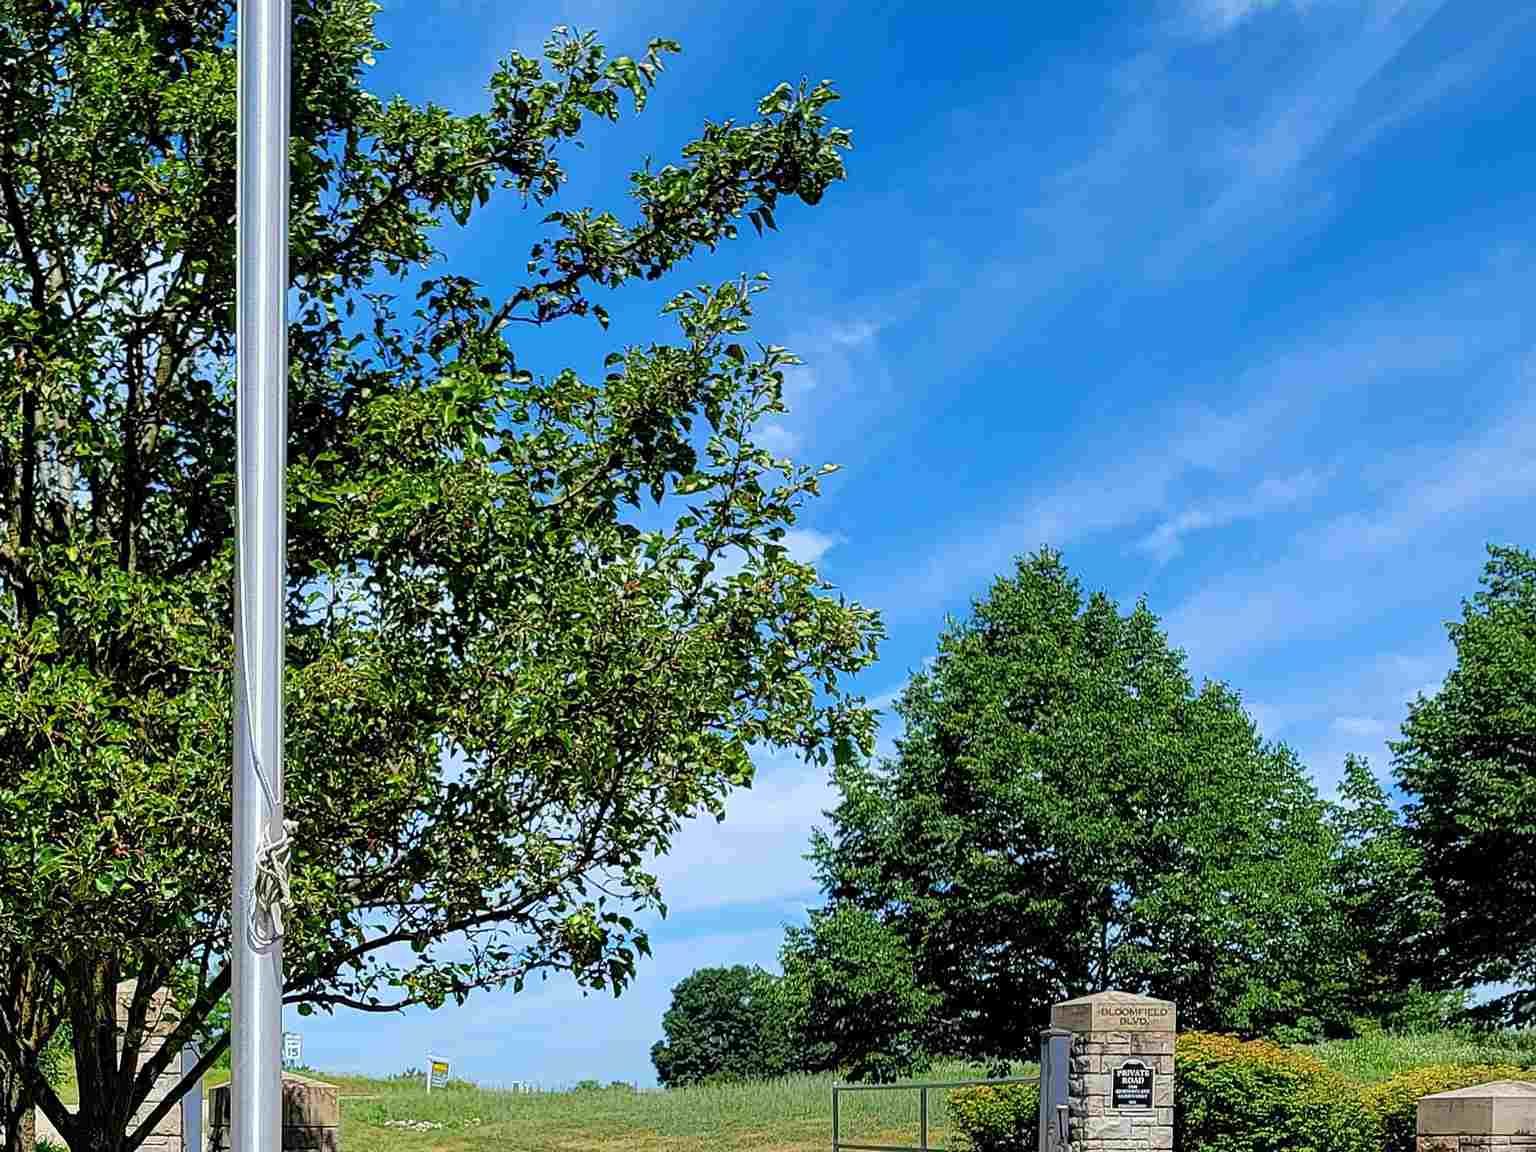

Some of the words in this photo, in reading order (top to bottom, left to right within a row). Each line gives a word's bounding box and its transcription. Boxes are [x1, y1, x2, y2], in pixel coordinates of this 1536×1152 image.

[1101, 1007, 1168, 1016] BLOOMFIELD
[288, 1048, 298, 1056] 15
[1117, 1069, 1150, 1077] PRIVATE
